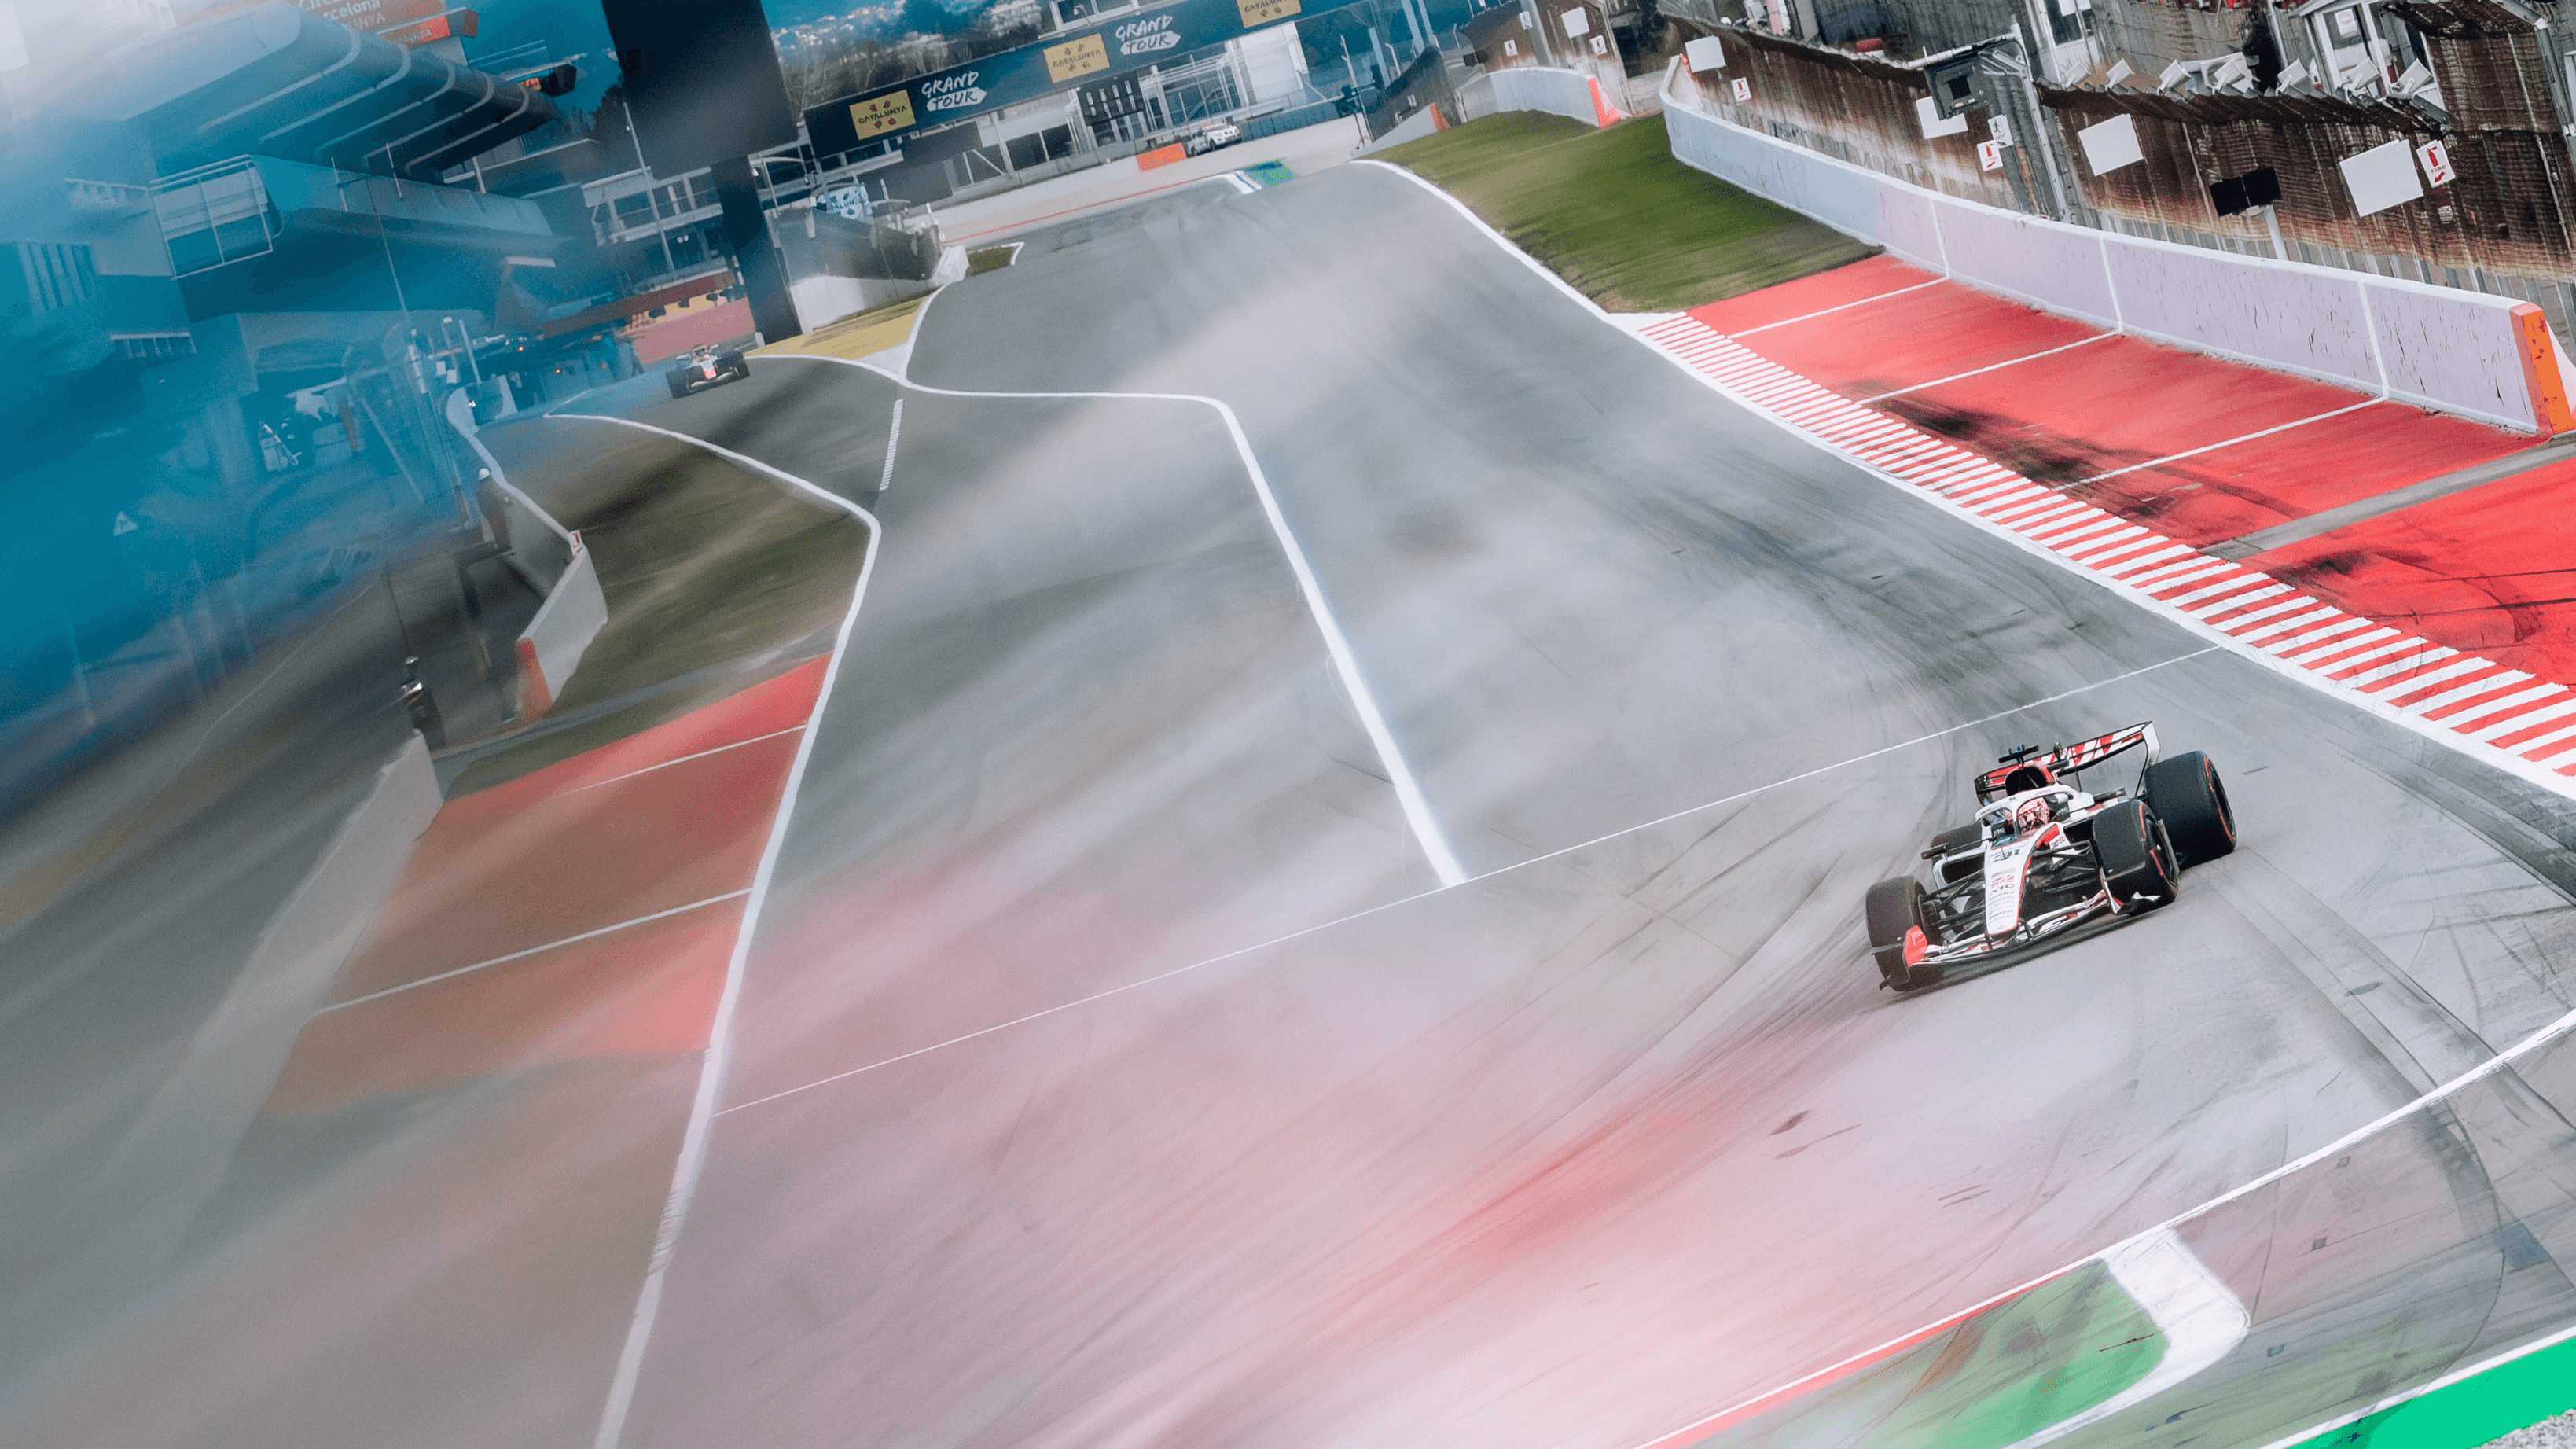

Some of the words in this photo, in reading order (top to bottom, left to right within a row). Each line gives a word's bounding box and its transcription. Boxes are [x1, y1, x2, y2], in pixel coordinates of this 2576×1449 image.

[1115, 14, 1174, 42] GRAND
[1125, 34, 1172, 54] TOUR
[1053, 49, 1101, 68] CATALUNYA
[921, 71, 979, 98] GRAND
[931, 90, 978, 109] TOUR
[858, 105, 907, 123] CATALUNYA
